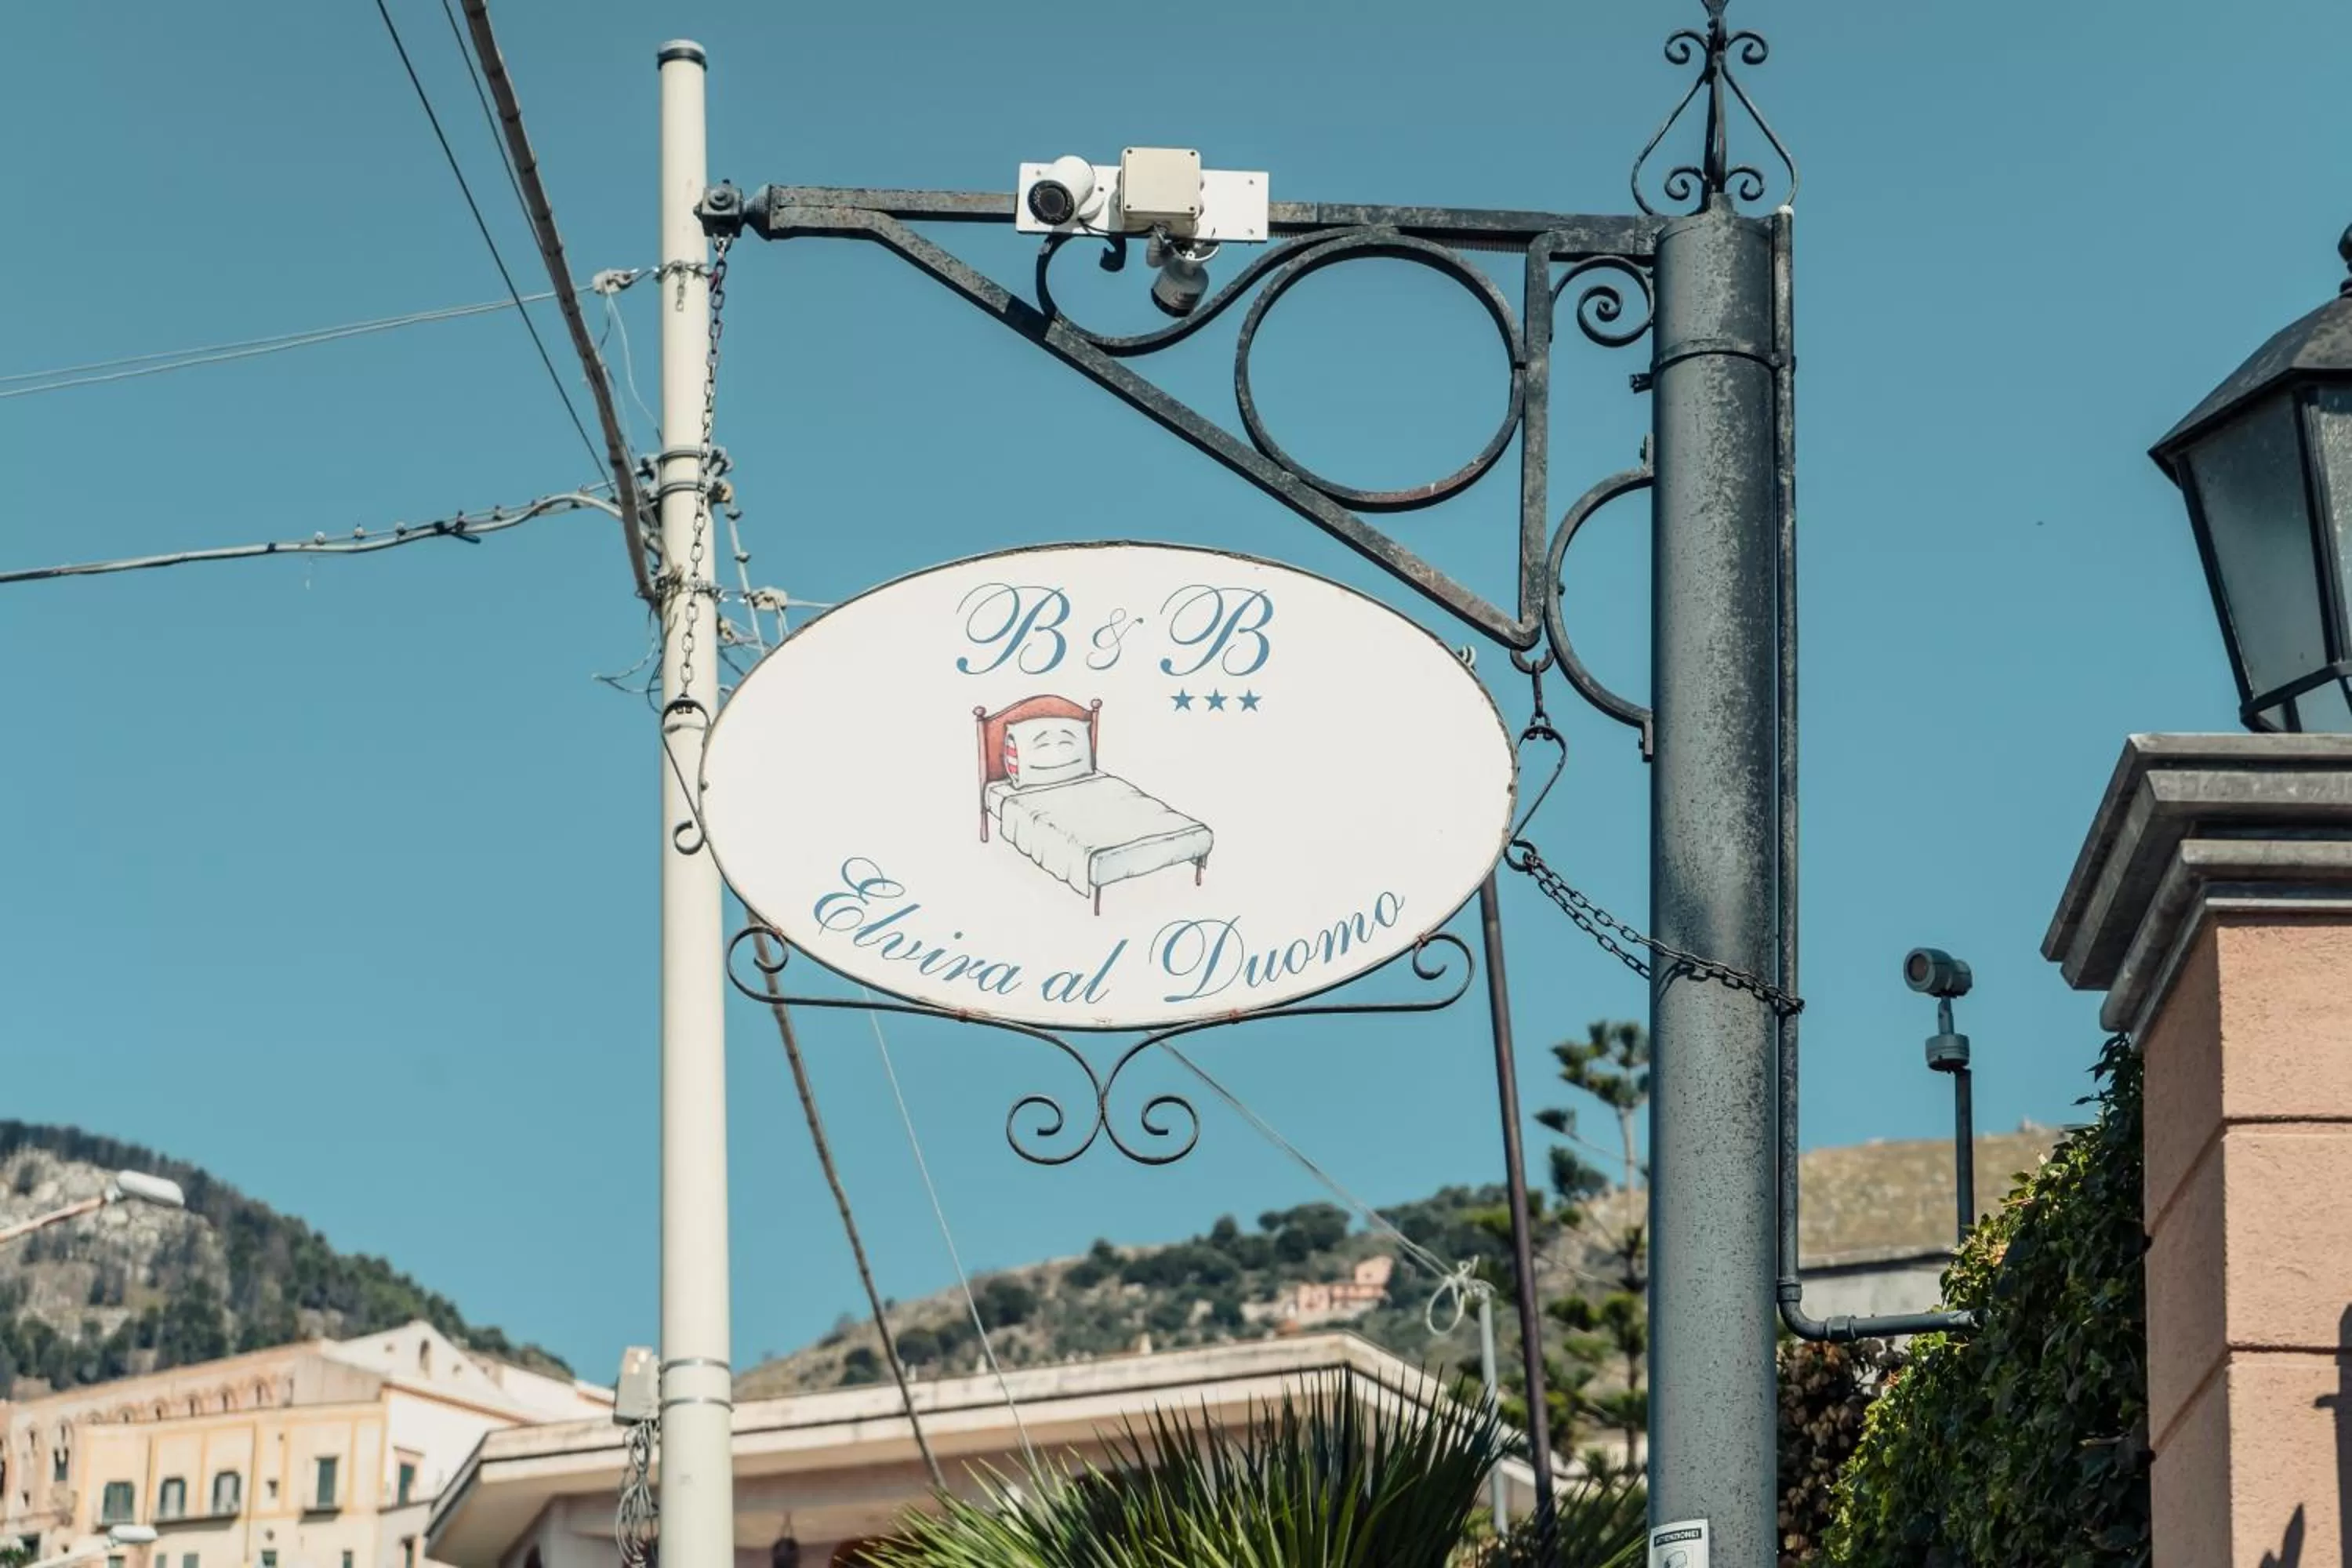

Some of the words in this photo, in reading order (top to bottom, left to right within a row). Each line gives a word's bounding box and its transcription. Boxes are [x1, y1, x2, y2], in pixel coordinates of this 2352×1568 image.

[956, 583, 1070, 674] B
[1086, 608, 1144, 670] &
[1160, 584, 1274, 676] B
[813, 857, 1022, 995] Elvira
[1041, 938, 1129, 1004] al
[1149, 891, 1406, 1003] Duomo
